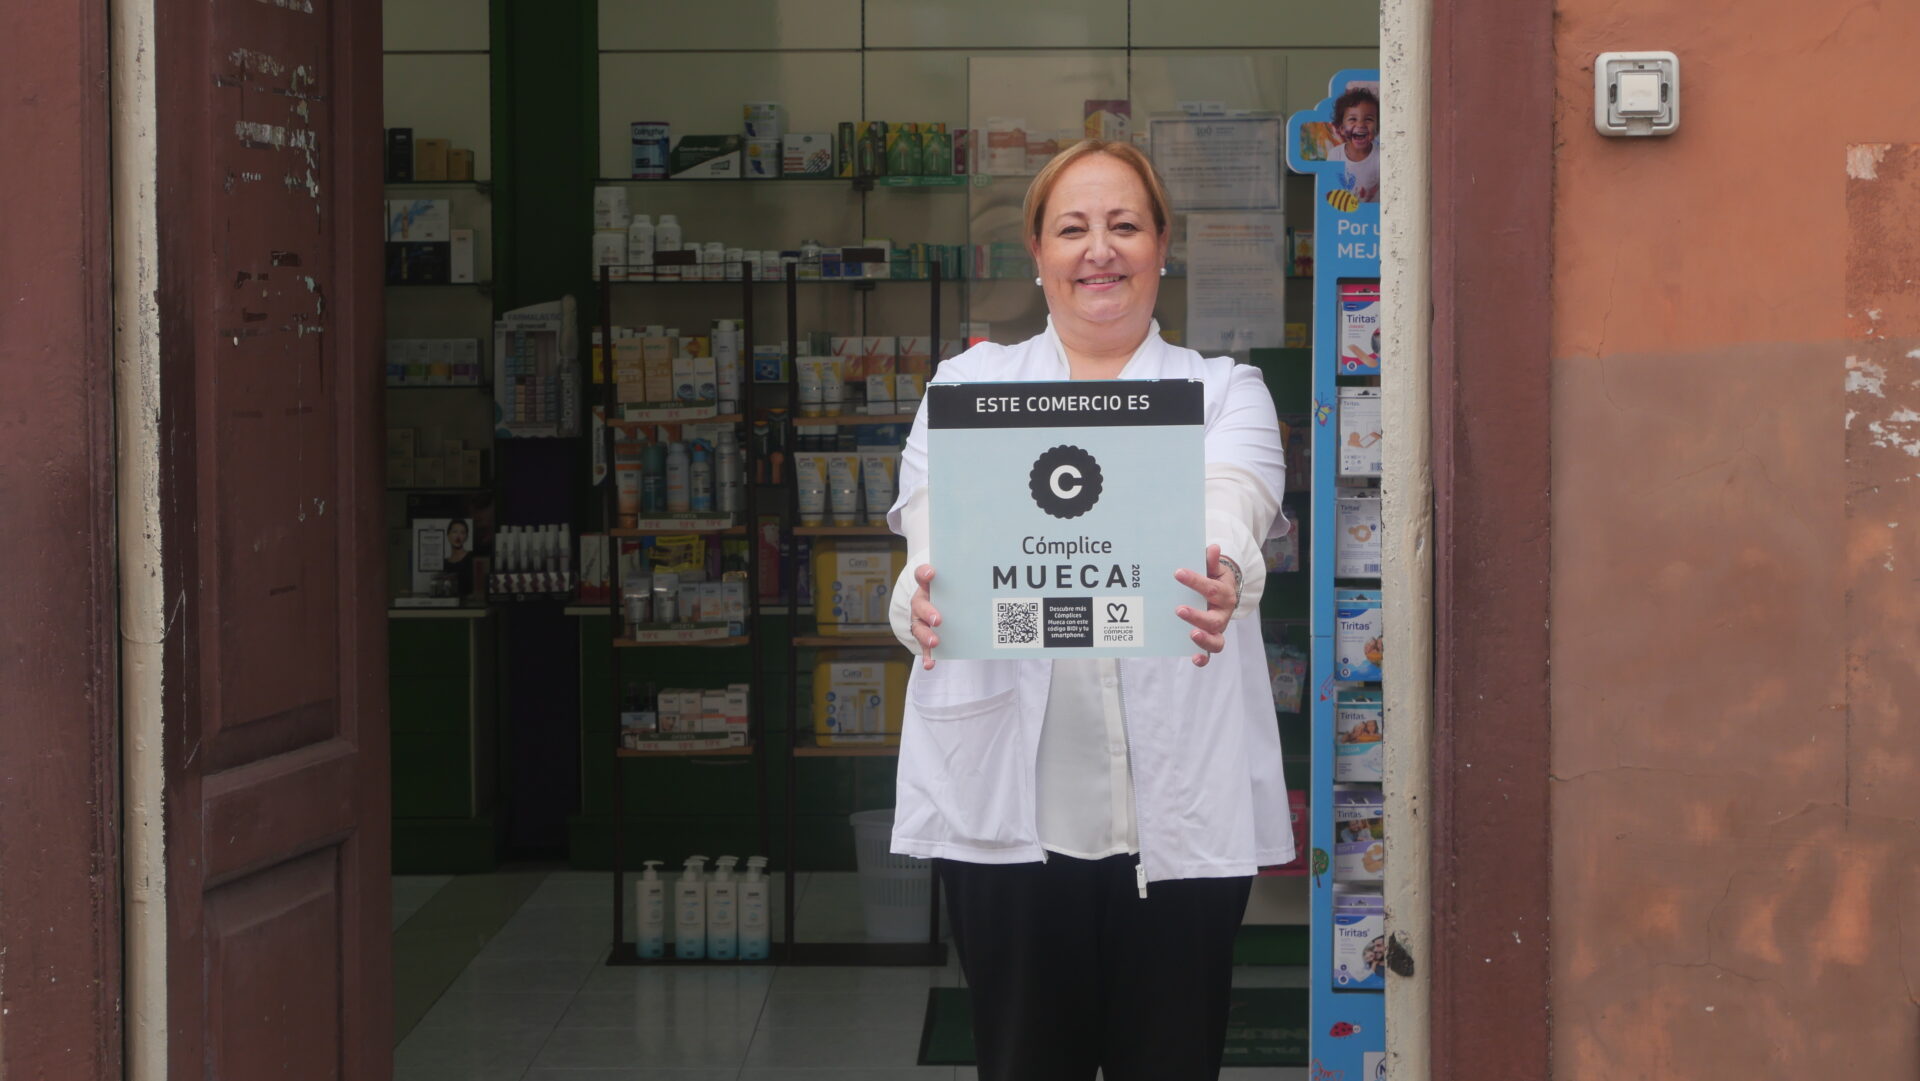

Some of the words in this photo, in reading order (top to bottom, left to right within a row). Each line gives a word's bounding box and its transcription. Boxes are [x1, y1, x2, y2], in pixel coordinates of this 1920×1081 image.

[1338, 219, 1368, 236] Por
[1338, 243, 1380, 259] MEJ
[1346, 314, 1376, 324] Tiritas
[976, 397, 1020, 413] ESTE
[1026, 395, 1122, 412] COMERCIO
[1127, 394, 1150, 410] ES
[1049, 464, 1083, 499] C
[1022, 536, 1112, 559] Cómplice
[992, 564, 1128, 589] MUECA
[1131, 563, 1141, 589] 2026
[1340, 621, 1370, 631] Tiritas
[1340, 712, 1365, 721] Tiritas
[1339, 928, 1368, 938] Tiritas
